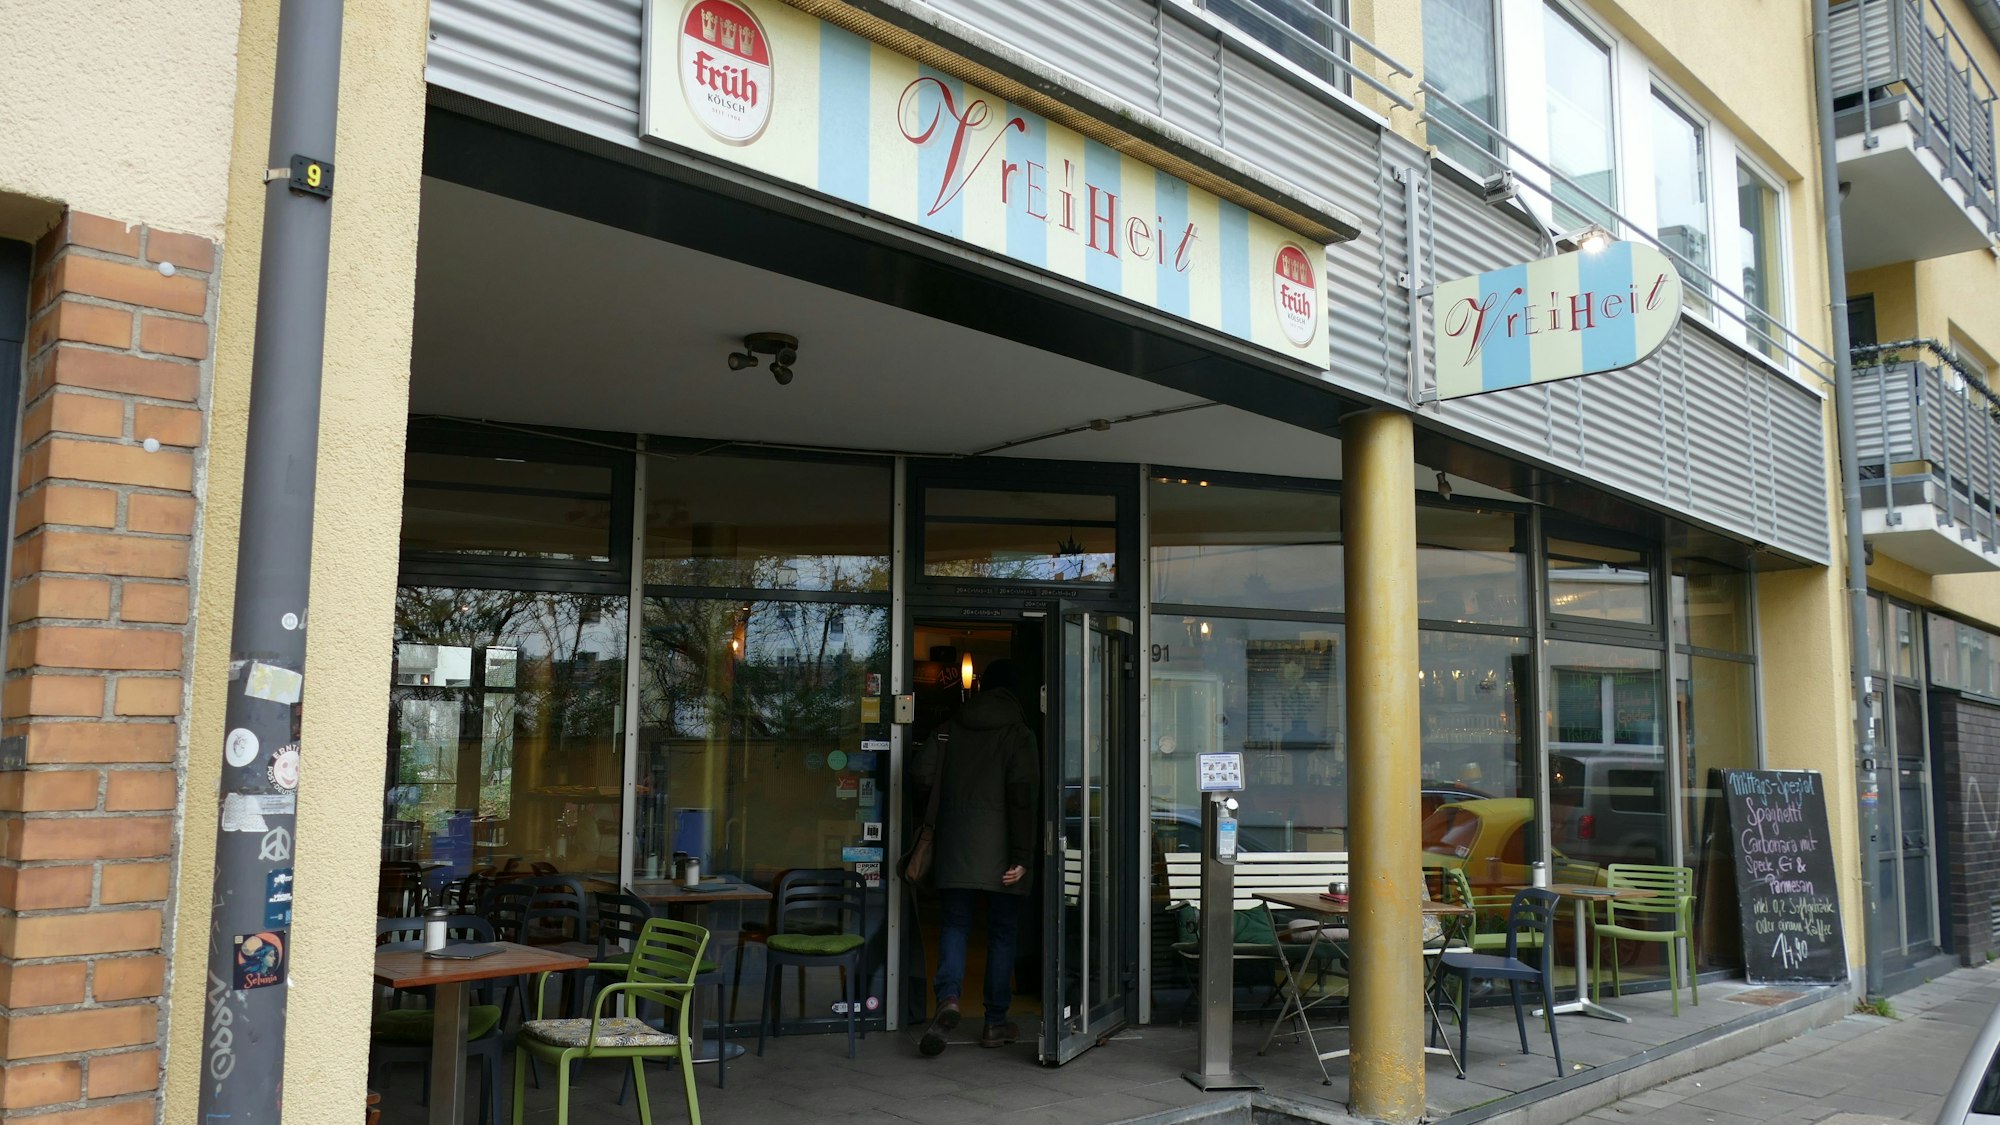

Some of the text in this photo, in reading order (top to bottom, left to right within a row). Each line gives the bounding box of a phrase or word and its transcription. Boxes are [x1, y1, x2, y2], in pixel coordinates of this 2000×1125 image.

[707, 93, 745, 114] KÖLSCH
[307, 163, 322, 187] 9
[1151, 643, 1170, 664] 91
[1746, 796, 1803, 836] Spaghetti
[1741, 828, 1818, 854] Carbonara mit
[1778, 855, 1793, 872] Ei
[1796, 856, 1807, 873] &
[1764, 873, 1814, 895] Parmesan
[1804, 918, 1833, 943] Kaffee
[1771, 932, 1808, 969] 14,90
